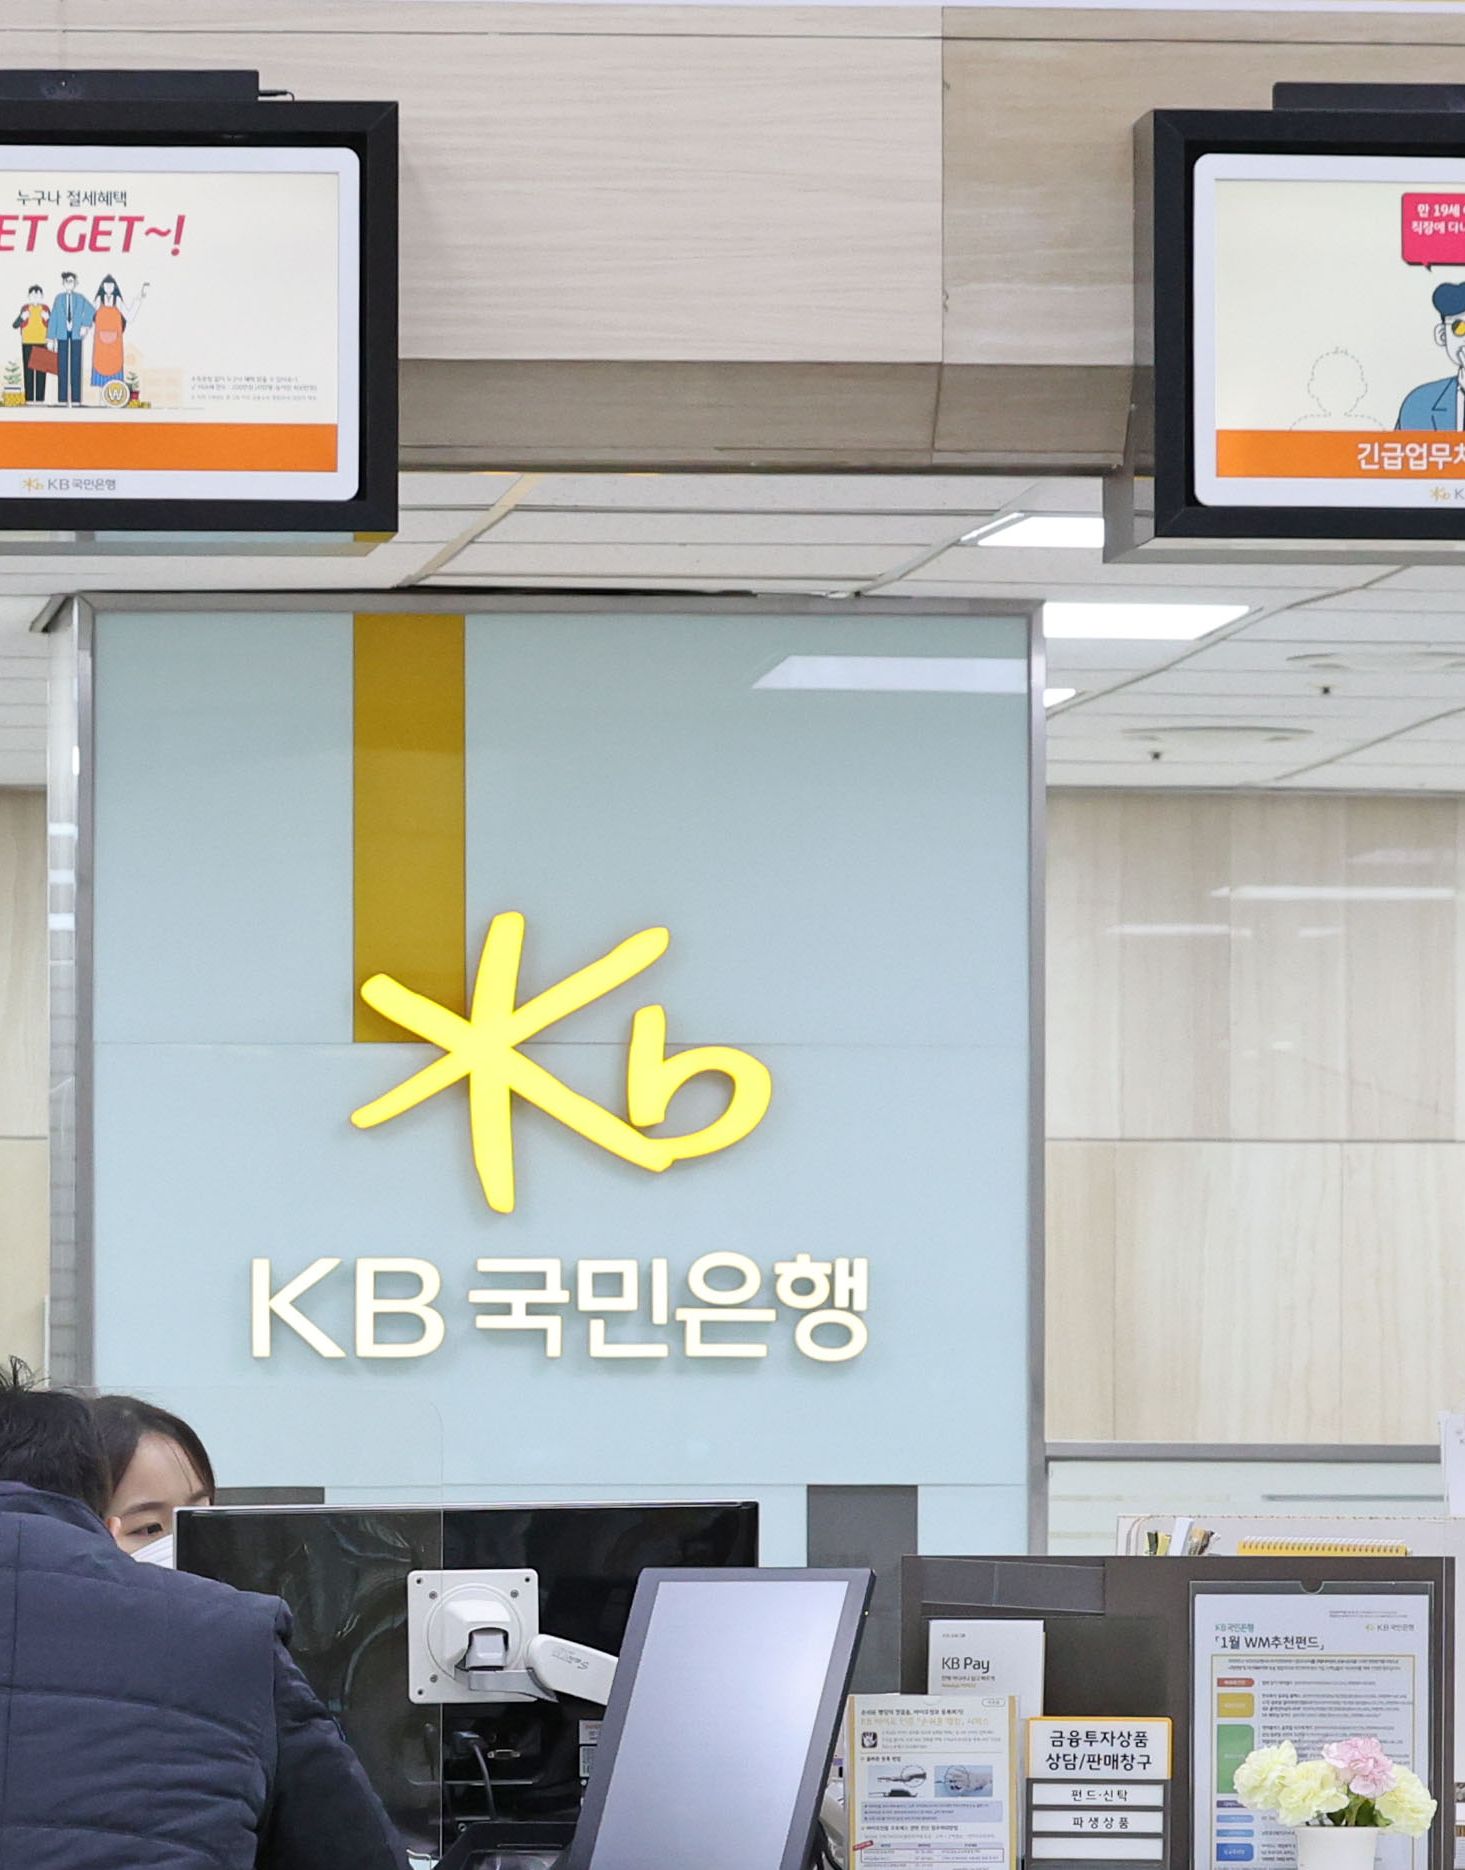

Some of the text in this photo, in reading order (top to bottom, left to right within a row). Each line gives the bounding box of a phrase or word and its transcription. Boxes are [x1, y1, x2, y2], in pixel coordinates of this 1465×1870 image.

[16, 190, 128, 208] 누구나 절세혜택
[1433, 203, 1461, 218] 19세
[56, 214, 187, 256] GET~!
[47, 477, 117, 492] KB 국민은행
[251, 1250, 869, 1362] KB 국민은행
[941, 1656, 990, 1674] KB Pay
[1049, 1730, 1150, 1748] 금융투자상품
[1045, 1753, 1153, 1772] 상담/판매창구
